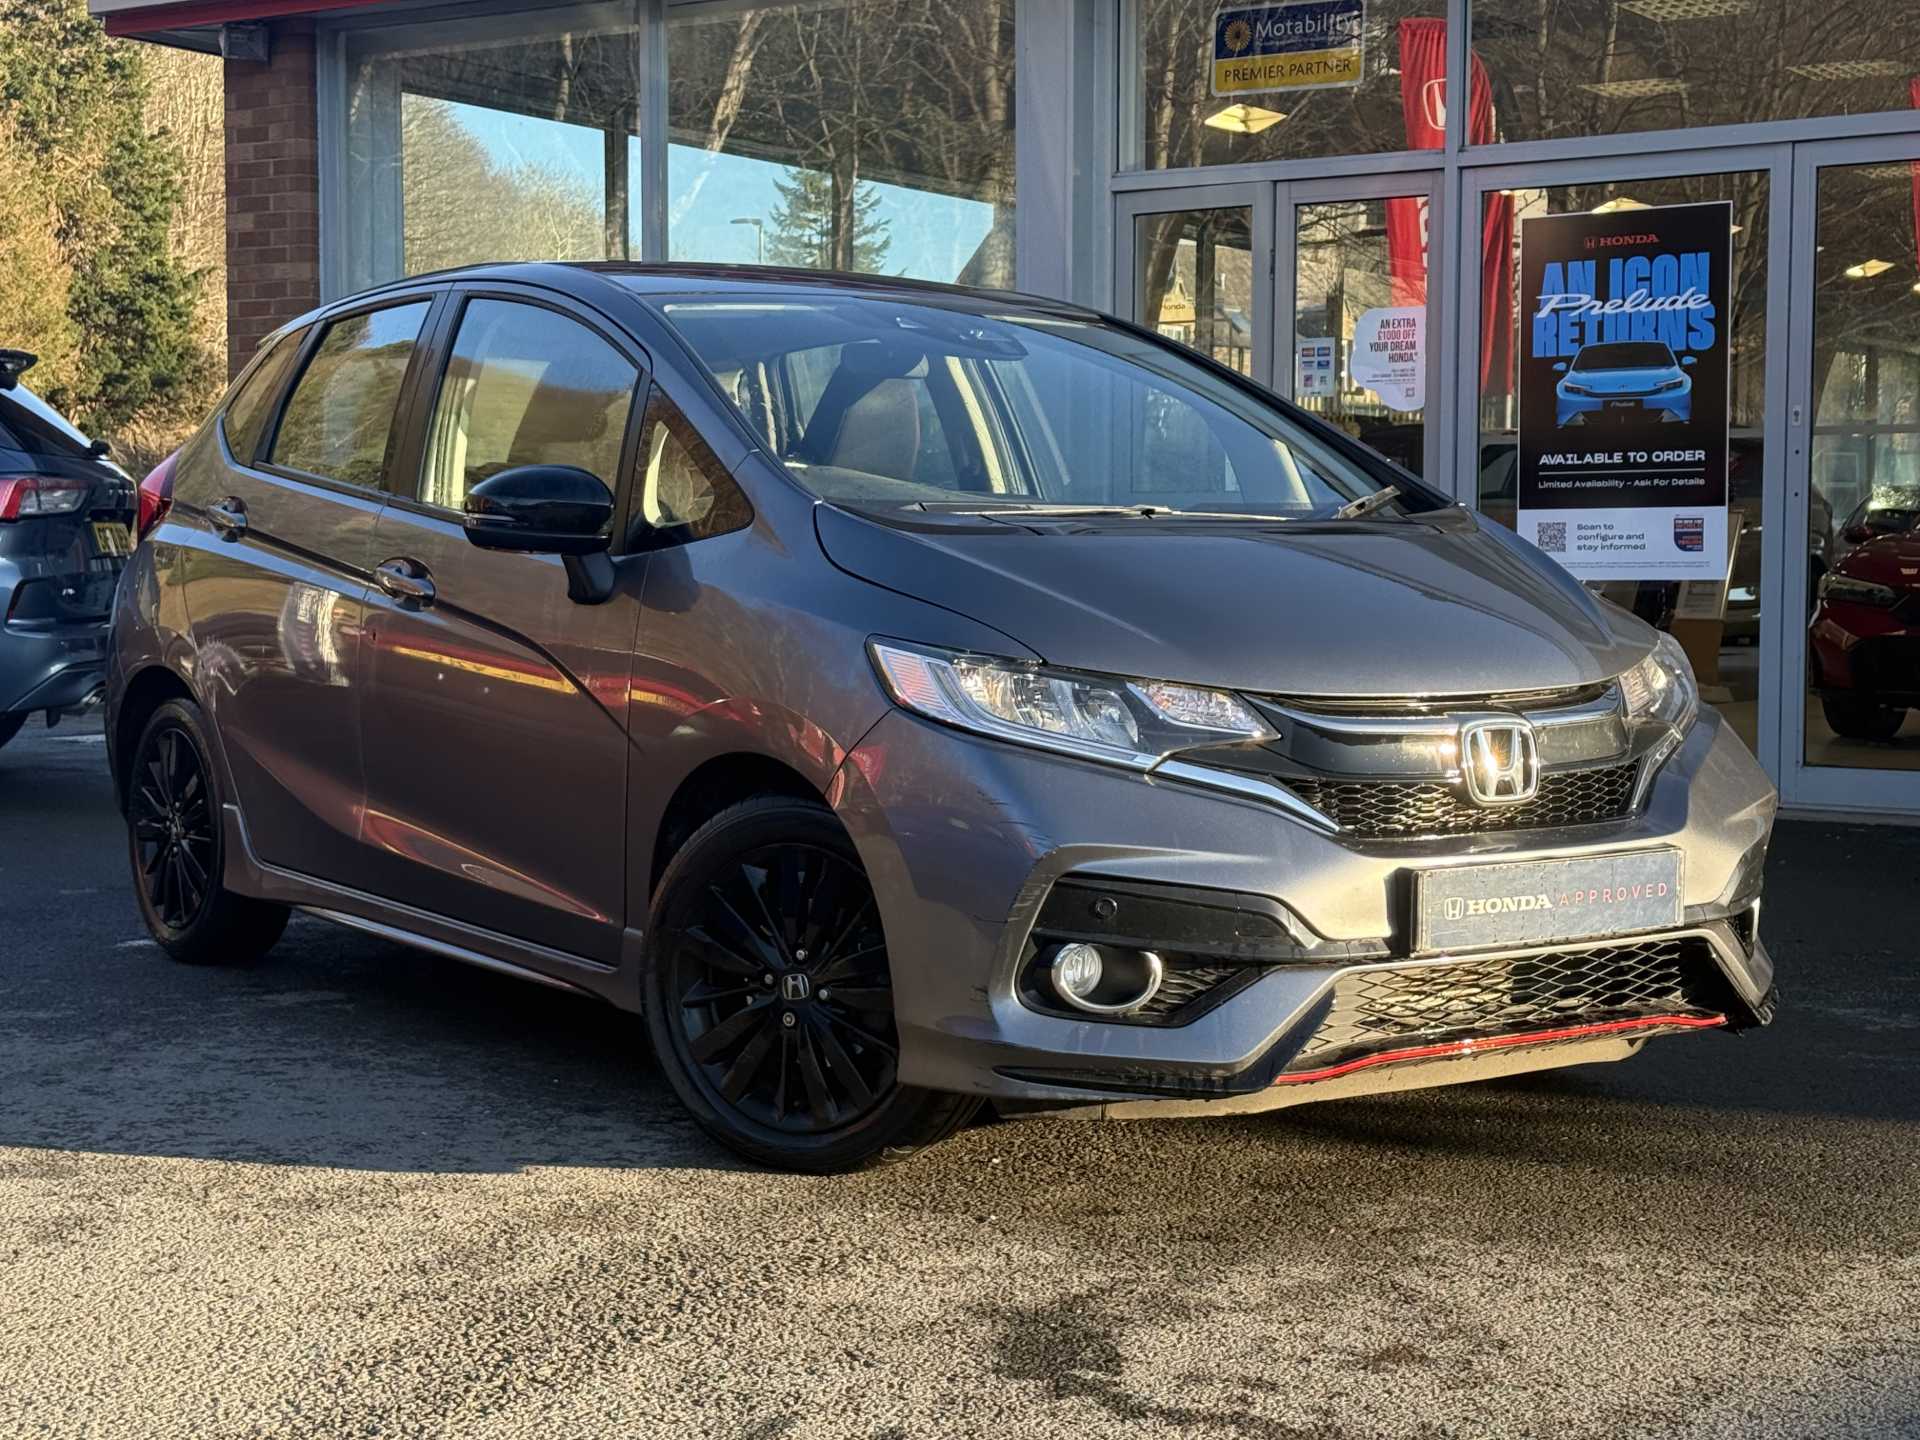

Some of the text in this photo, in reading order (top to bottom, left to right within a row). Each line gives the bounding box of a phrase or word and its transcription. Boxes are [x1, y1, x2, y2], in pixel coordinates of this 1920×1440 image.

[1255, 12, 1353, 39] Motability
[1224, 59, 1352, 82] PREMIER PARTNER
[1599, 234, 1660, 247] HONDA
[1539, 252, 1710, 311] AN ICON
[1536, 286, 1711, 318] Prelude
[1380, 318, 1416, 329] AN EXTRA
[1378, 329, 1416, 340] £1000 OFF
[1532, 303, 1716, 358] RETURNS
[1369, 341, 1416, 352] YOUR DREAM
[1539, 450, 1705, 465] AVAILABLE TO ORDER
[1538, 480, 1573, 489] Limited
[1575, 479, 1625, 489] Availability
[1634, 478, 1651, 487] Ask
[1653, 478, 1669, 487] For
[1671, 477, 1705, 486] Details
[1577, 523, 1614, 531] Scan to
[1577, 533, 1645, 543] configure and
[1577, 543, 1646, 552] stay informed
[1467, 882, 1668, 916] HONDA APPROVED
